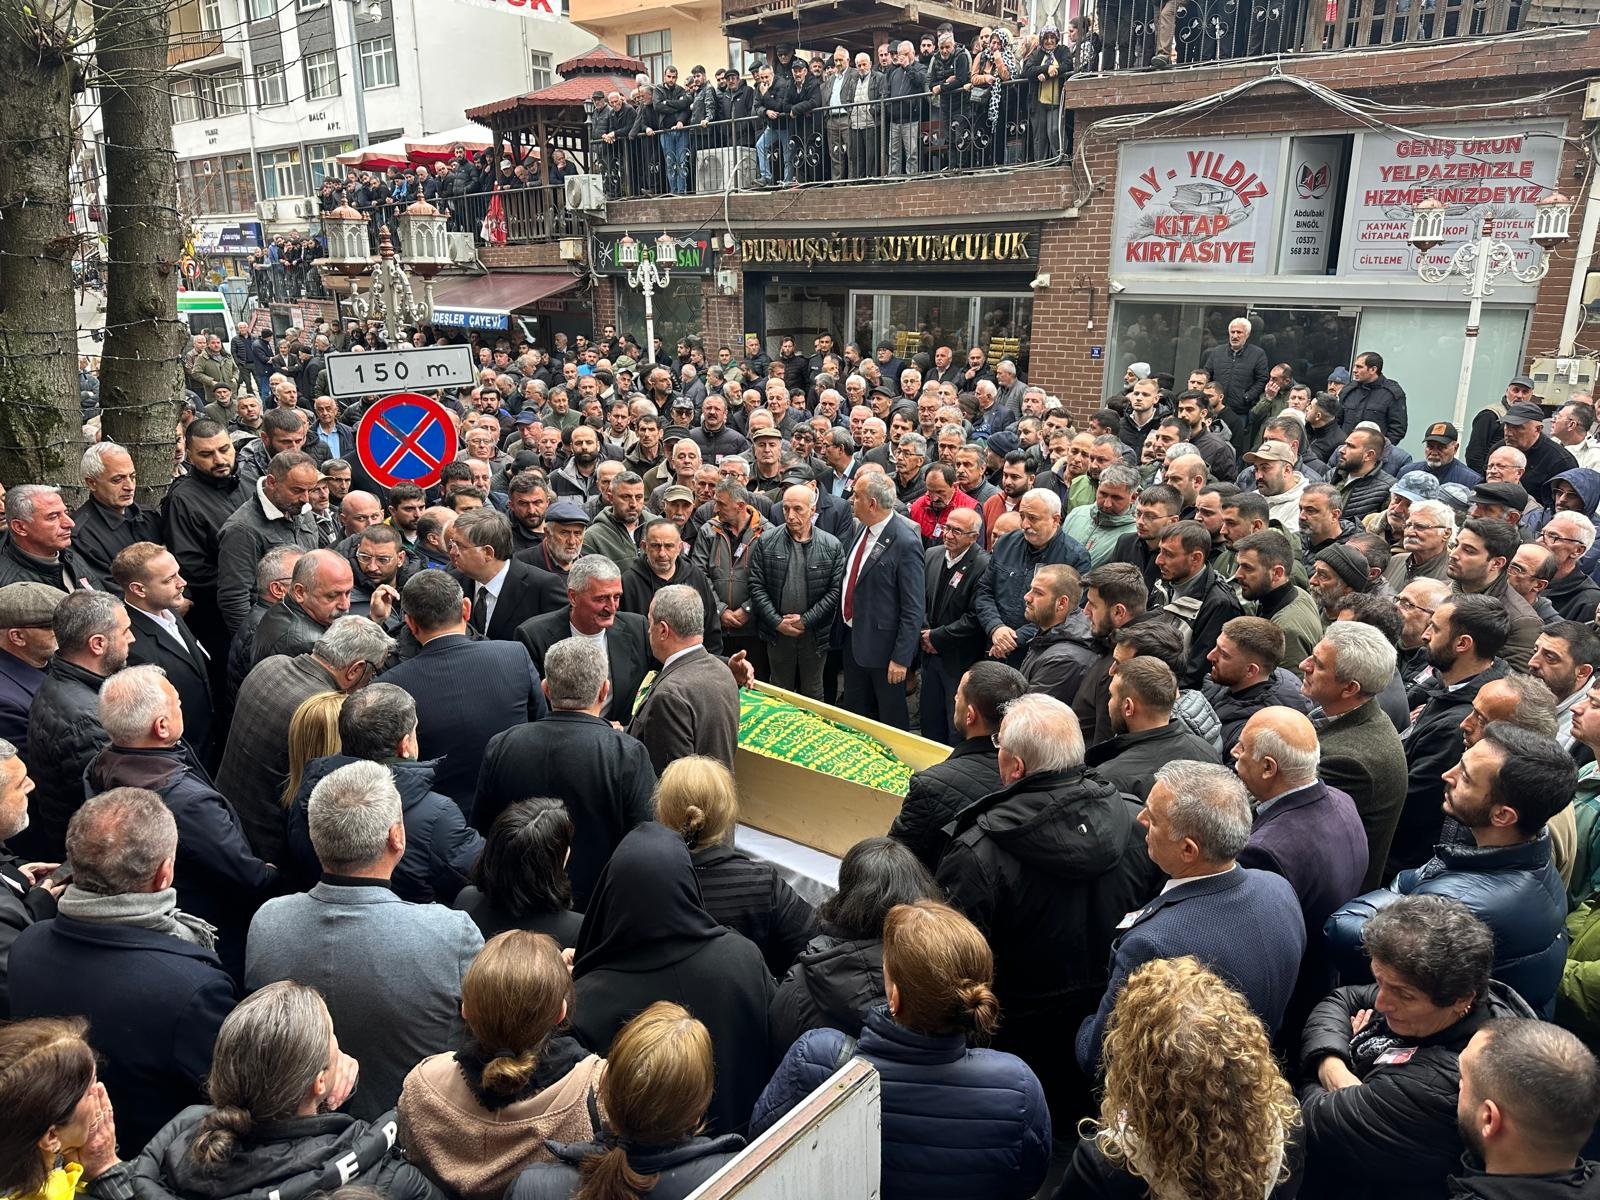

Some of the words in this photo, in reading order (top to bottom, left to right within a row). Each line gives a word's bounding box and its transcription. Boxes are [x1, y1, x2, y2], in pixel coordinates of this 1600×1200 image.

[1127, 166, 1162, 210] AY
[1187, 150, 1269, 208] YILDIZ
[1293, 209, 1325, 217] Abdulbaki
[1154, 213, 1229, 236] KİTAP
[1366, 222, 1407, 231] KAYNAK
[1492, 220, 1534, 229] EDİYELİK
[1361, 230, 1409, 240] KİTAPLAR
[1295, 236, 1316, 245] (0537)
[741, 232, 865, 271] DURMUŞOĞLU
[874, 232, 1030, 261] KUYUMCULUK
[1126, 241, 1255, 263] KIRTASİYE
[1360, 255, 1402, 265] CİLTLEME
[354, 361, 409, 383] 150
